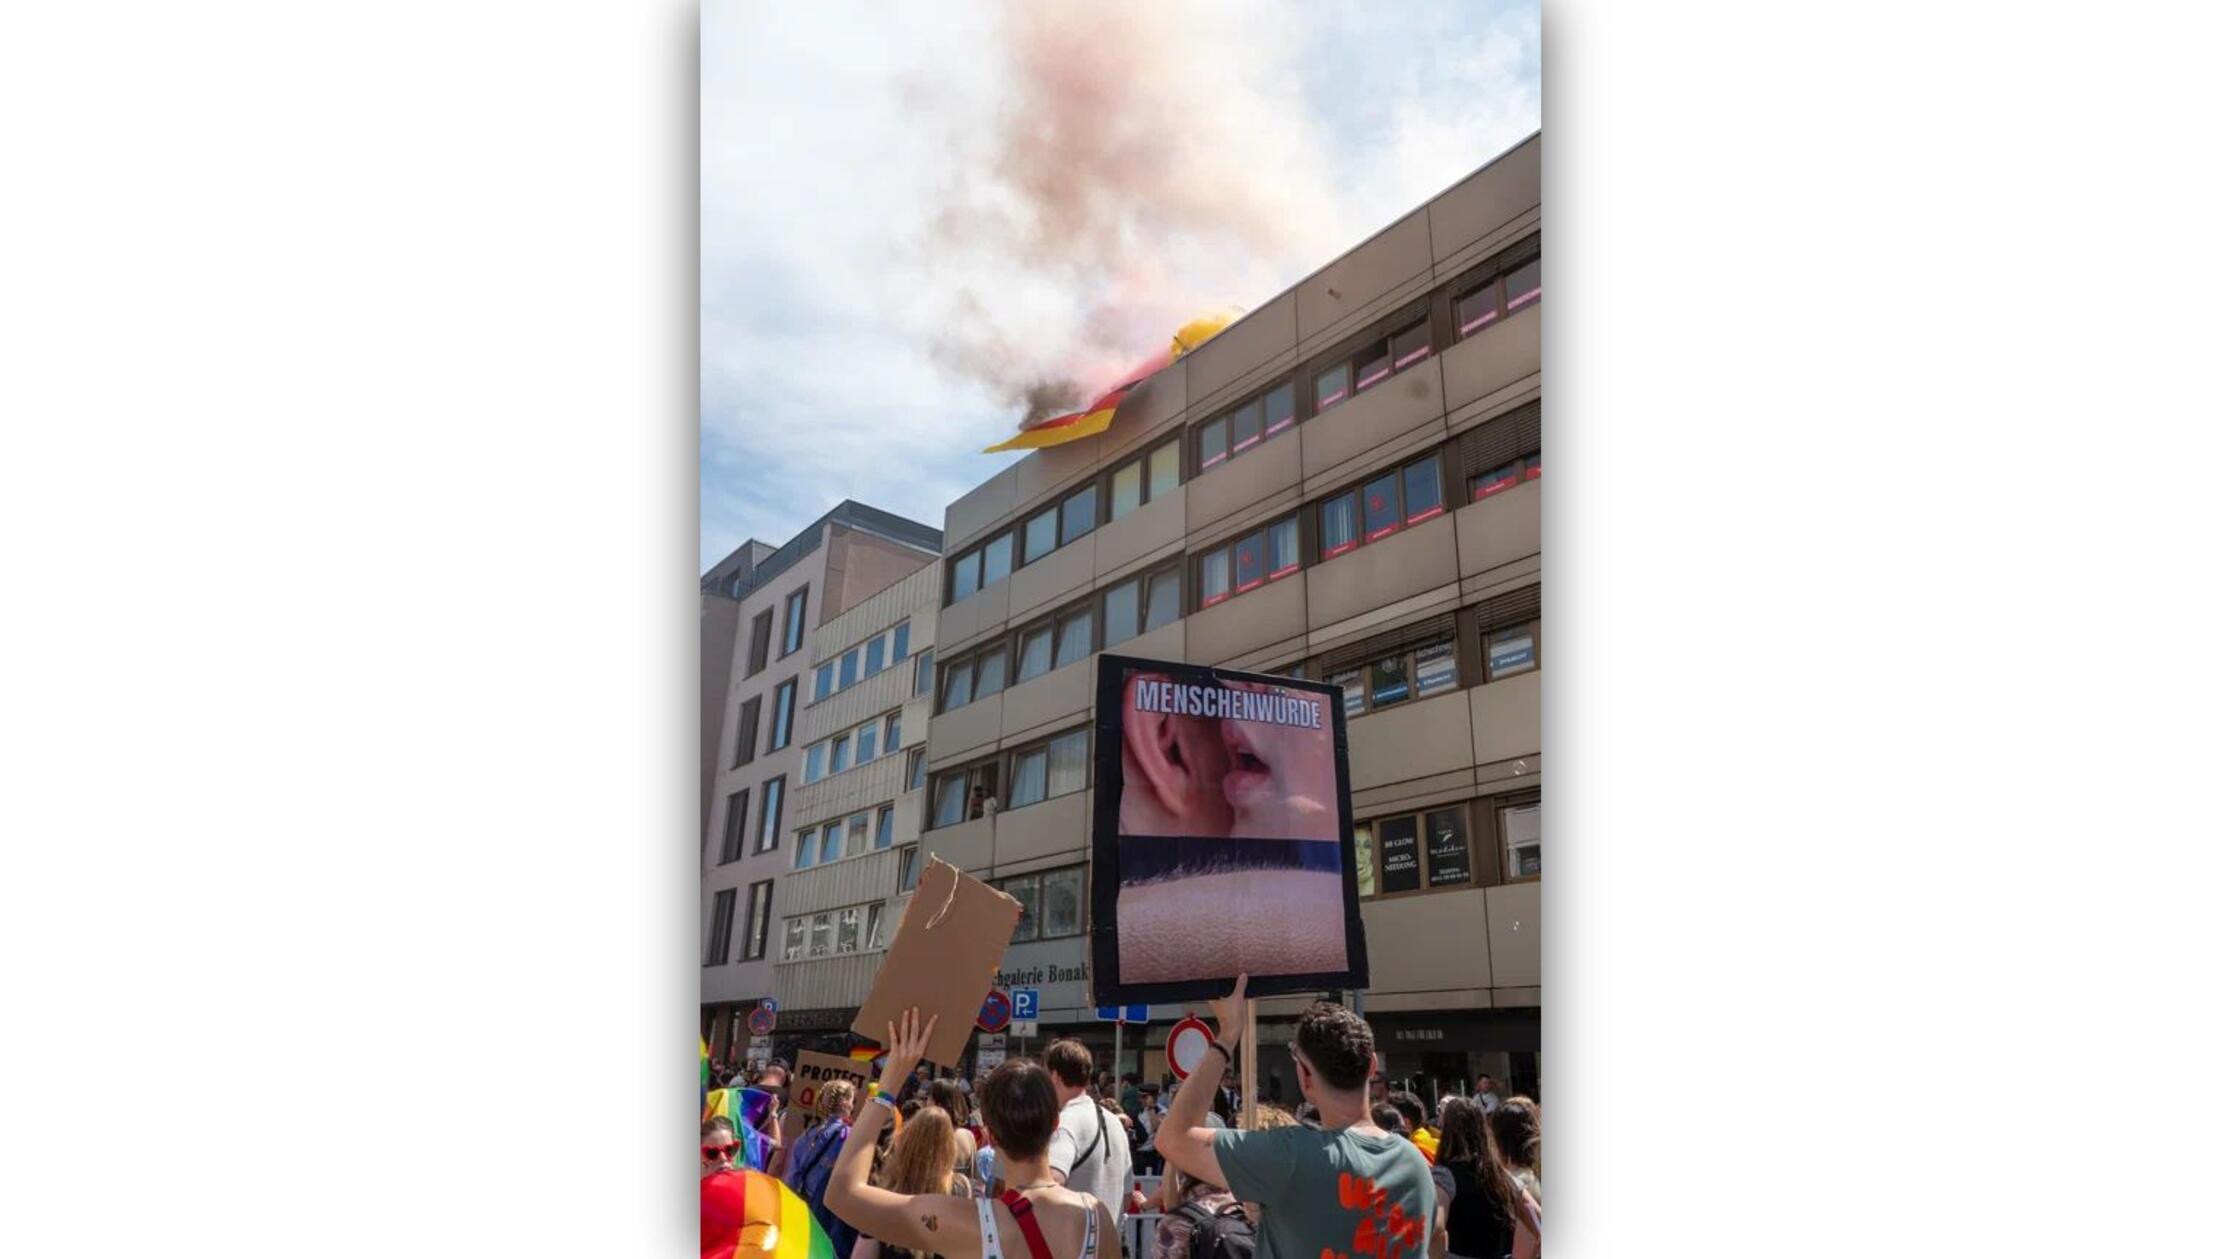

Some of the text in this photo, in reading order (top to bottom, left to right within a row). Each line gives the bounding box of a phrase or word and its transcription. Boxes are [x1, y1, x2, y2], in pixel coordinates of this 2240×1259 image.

[1135, 679, 1321, 729] MENSCHENWÜRDE
[1016, 994, 1031, 1016] P
[801, 1064, 866, 1089] PROTECT
